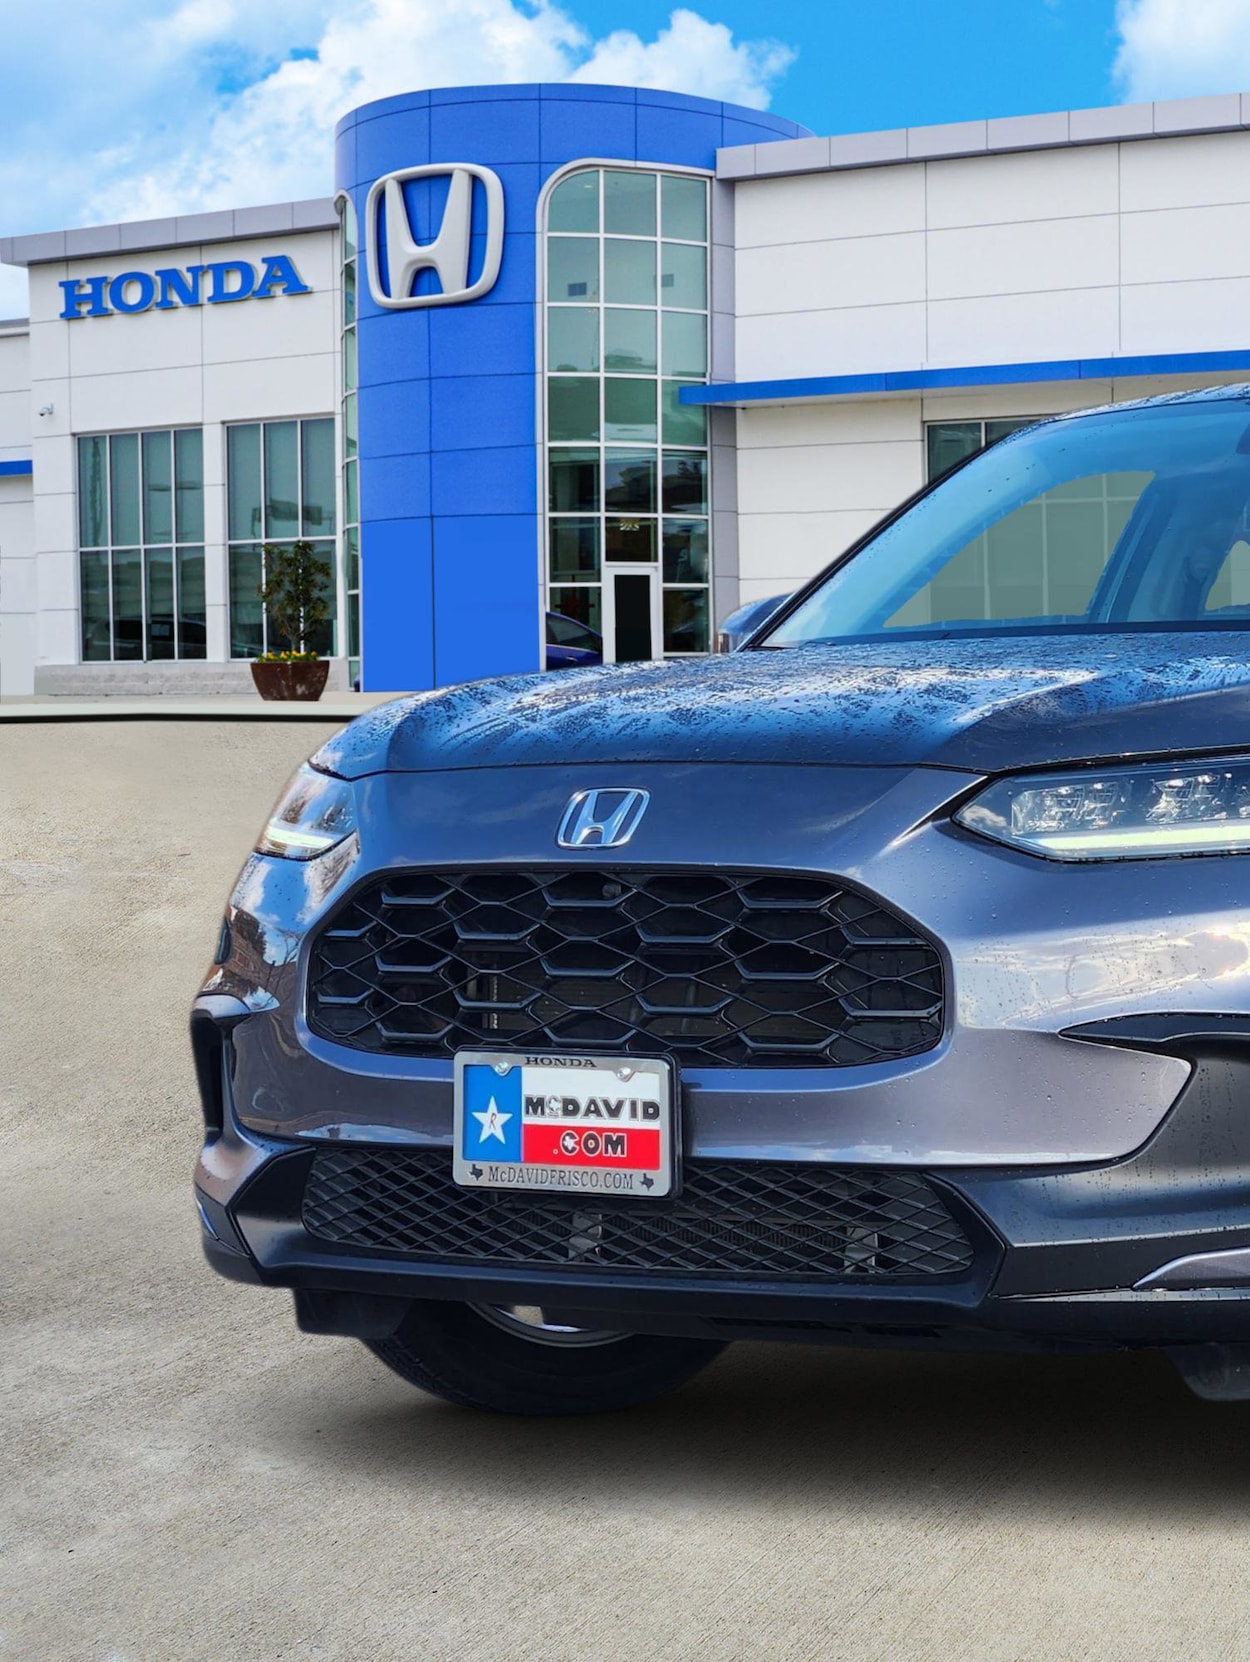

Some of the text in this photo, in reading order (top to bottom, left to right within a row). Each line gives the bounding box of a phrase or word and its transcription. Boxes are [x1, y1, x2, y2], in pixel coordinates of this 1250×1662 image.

[59, 255, 311, 319] HONDA
[524, 1056, 597, 1068] HONDA
[488, 1166, 634, 1190] McDAVIDFRISCO.COM
